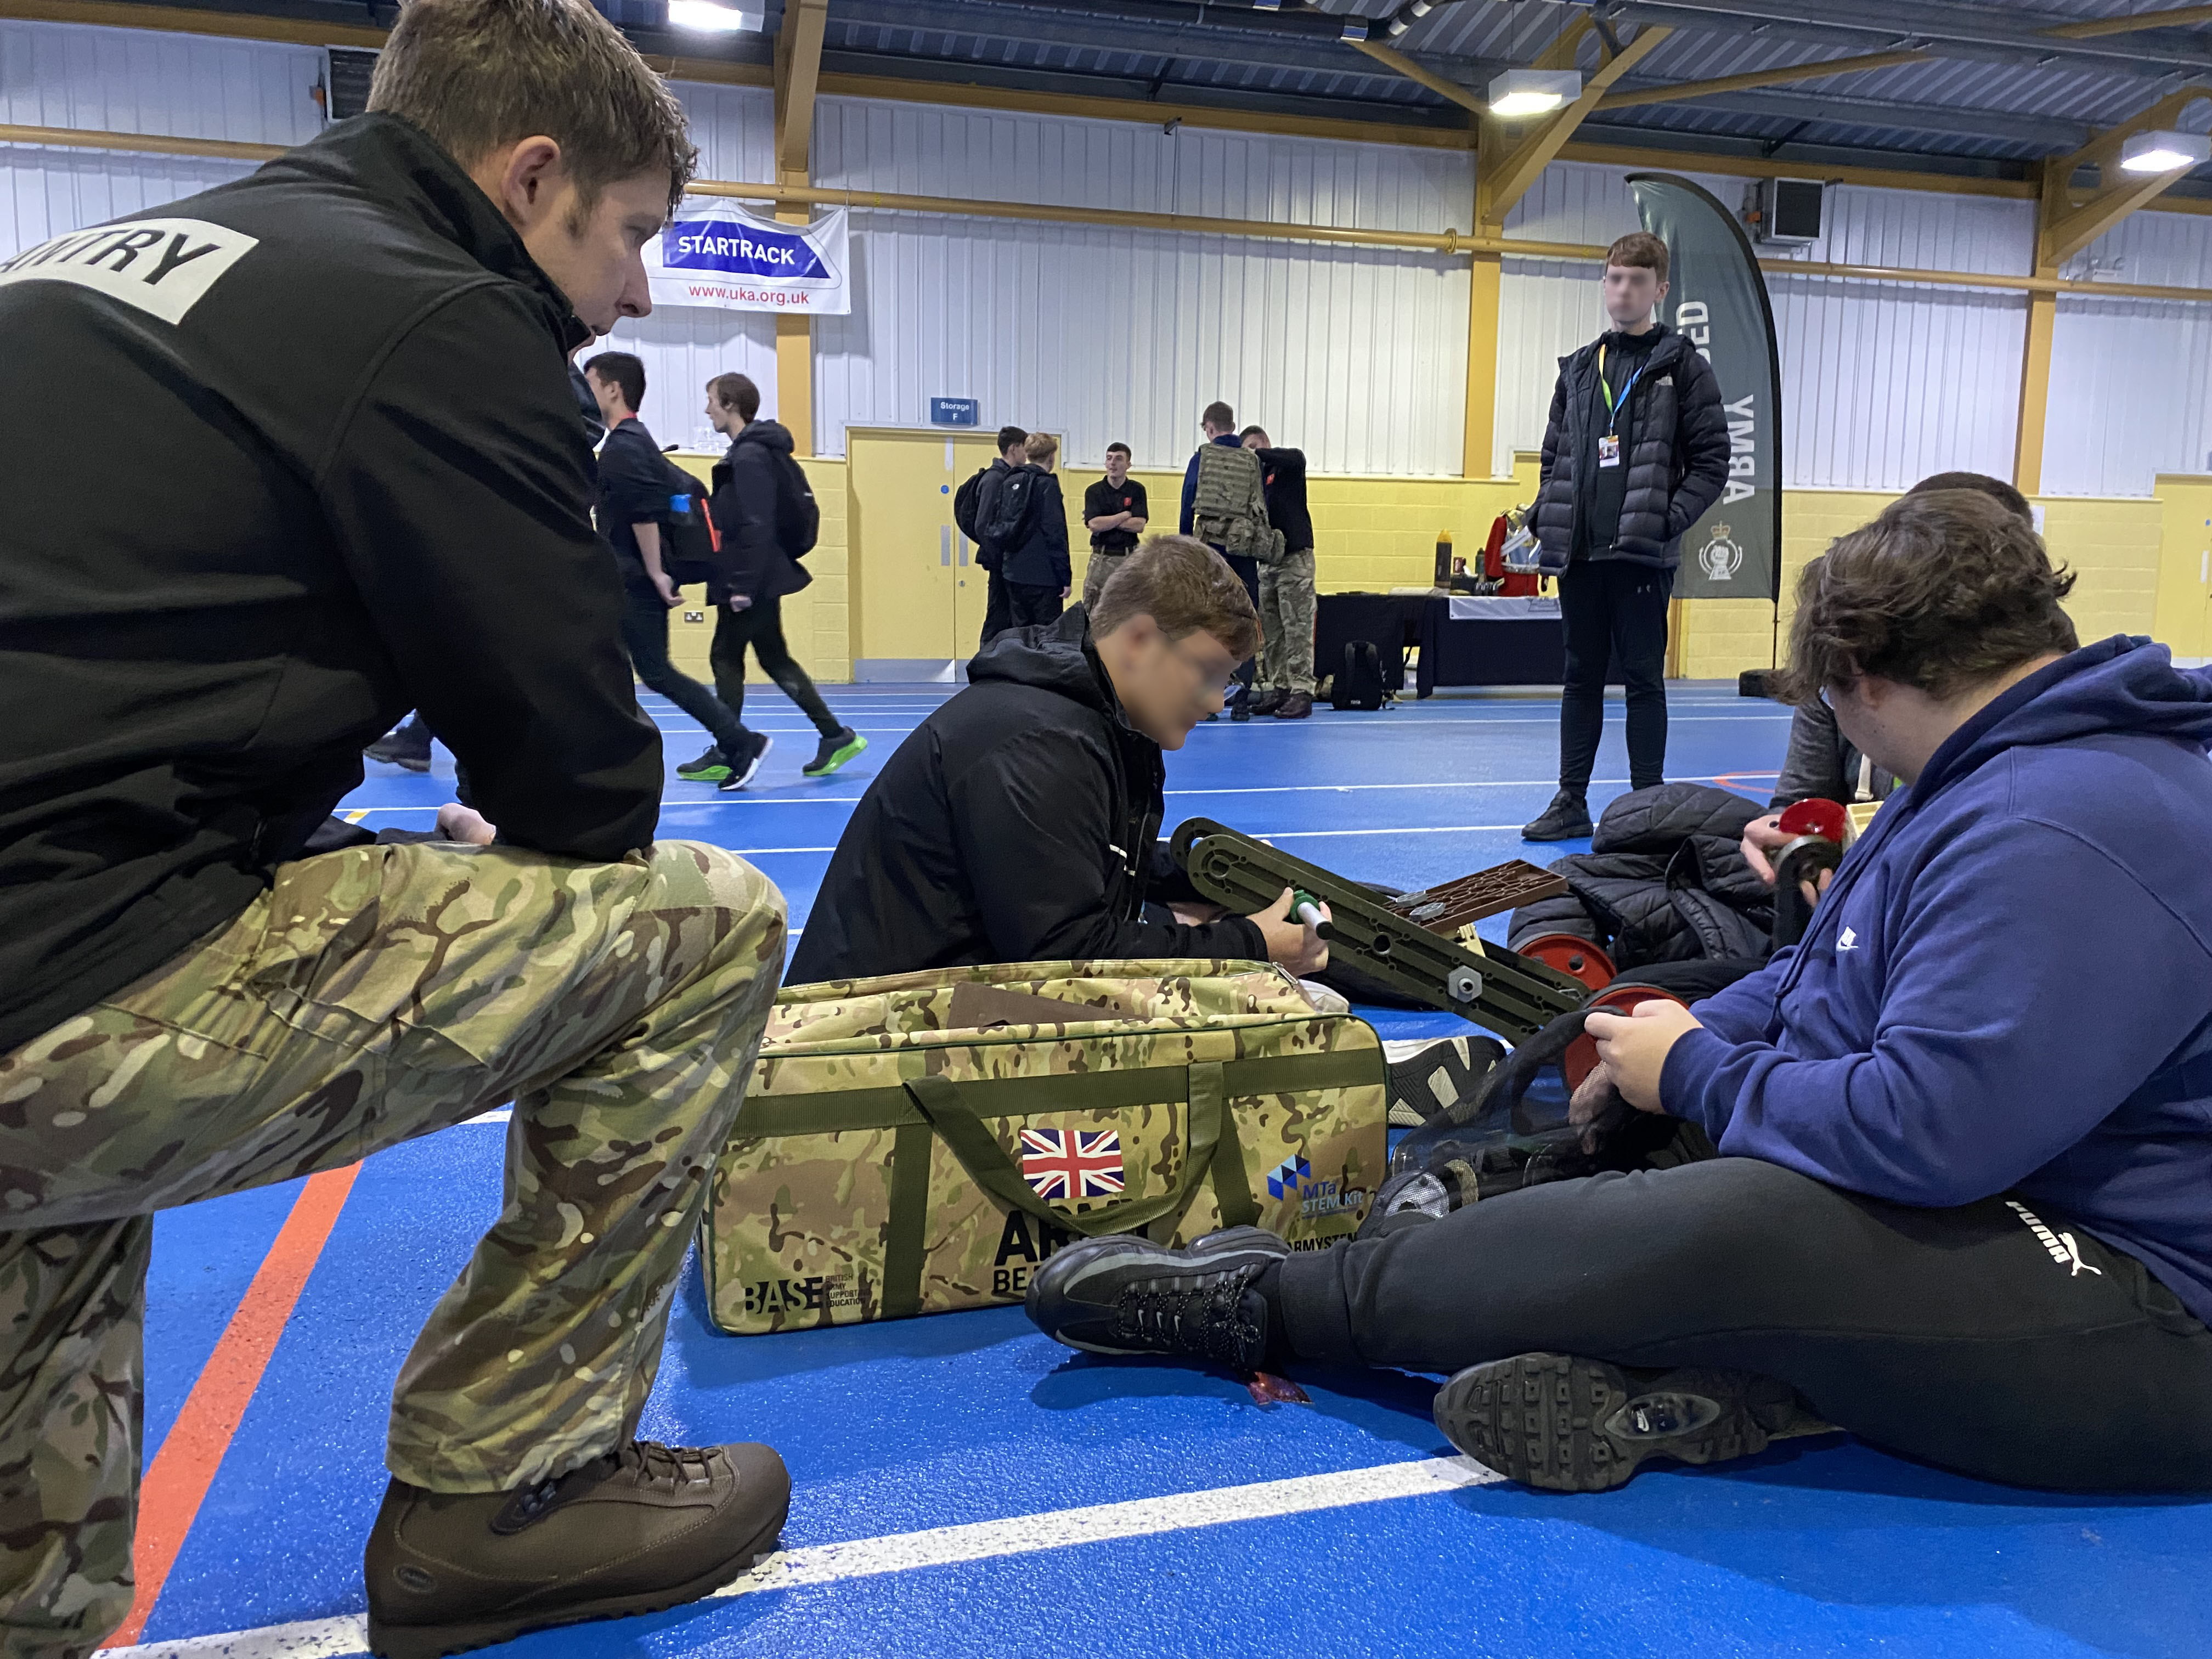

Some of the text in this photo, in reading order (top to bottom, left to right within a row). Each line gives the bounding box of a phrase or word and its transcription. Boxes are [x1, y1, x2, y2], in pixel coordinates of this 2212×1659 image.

[678, 235, 795, 265] STARTRACK
[689, 286, 809, 306] www.uka.org.uk
[940, 402, 969, 411] Storage
[1301, 1195, 1340, 1214] STEM
[1345, 1190, 1363, 1206] Kit
[2005, 1201, 2072, 1264] PUMA
[825, 1273, 854, 1282] BRITISH
[745, 1276, 823, 1315] BASE
